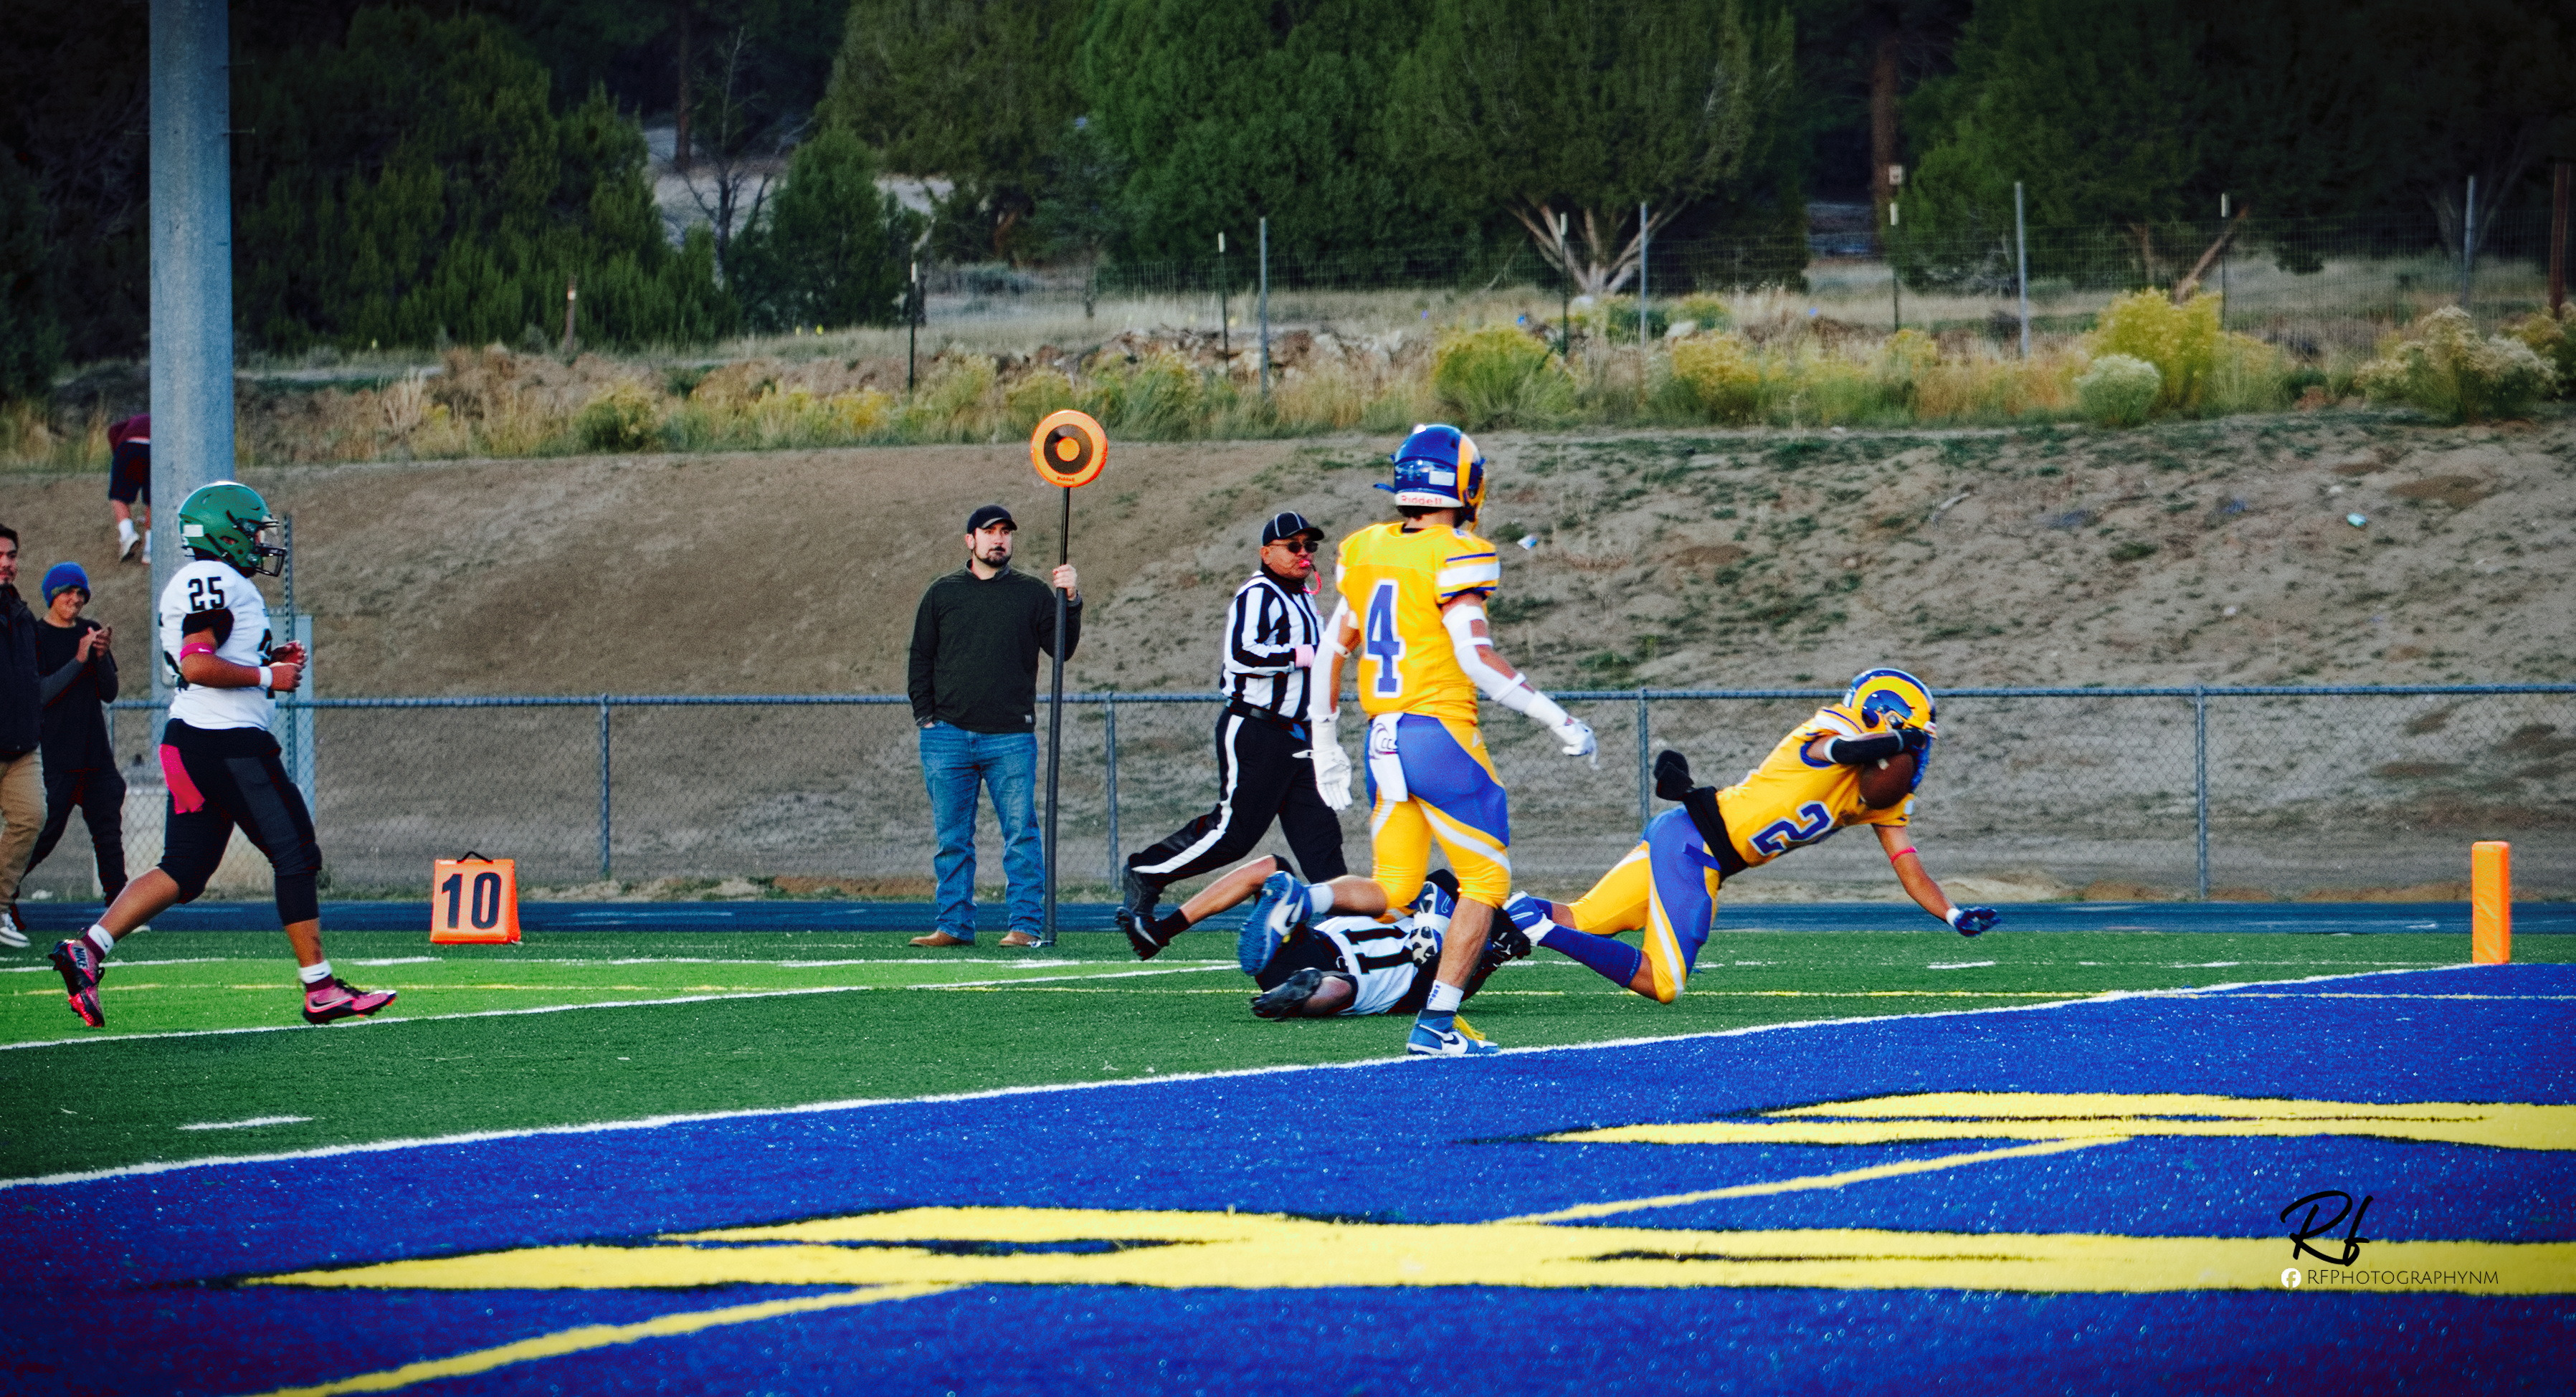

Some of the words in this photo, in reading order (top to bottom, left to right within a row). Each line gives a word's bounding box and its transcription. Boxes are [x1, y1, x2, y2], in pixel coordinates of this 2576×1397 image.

[187, 576, 225, 611] 25
[1365, 580, 1405, 697] 4
[442, 872, 501, 930] 10
[1339, 925, 1414, 975] 11
